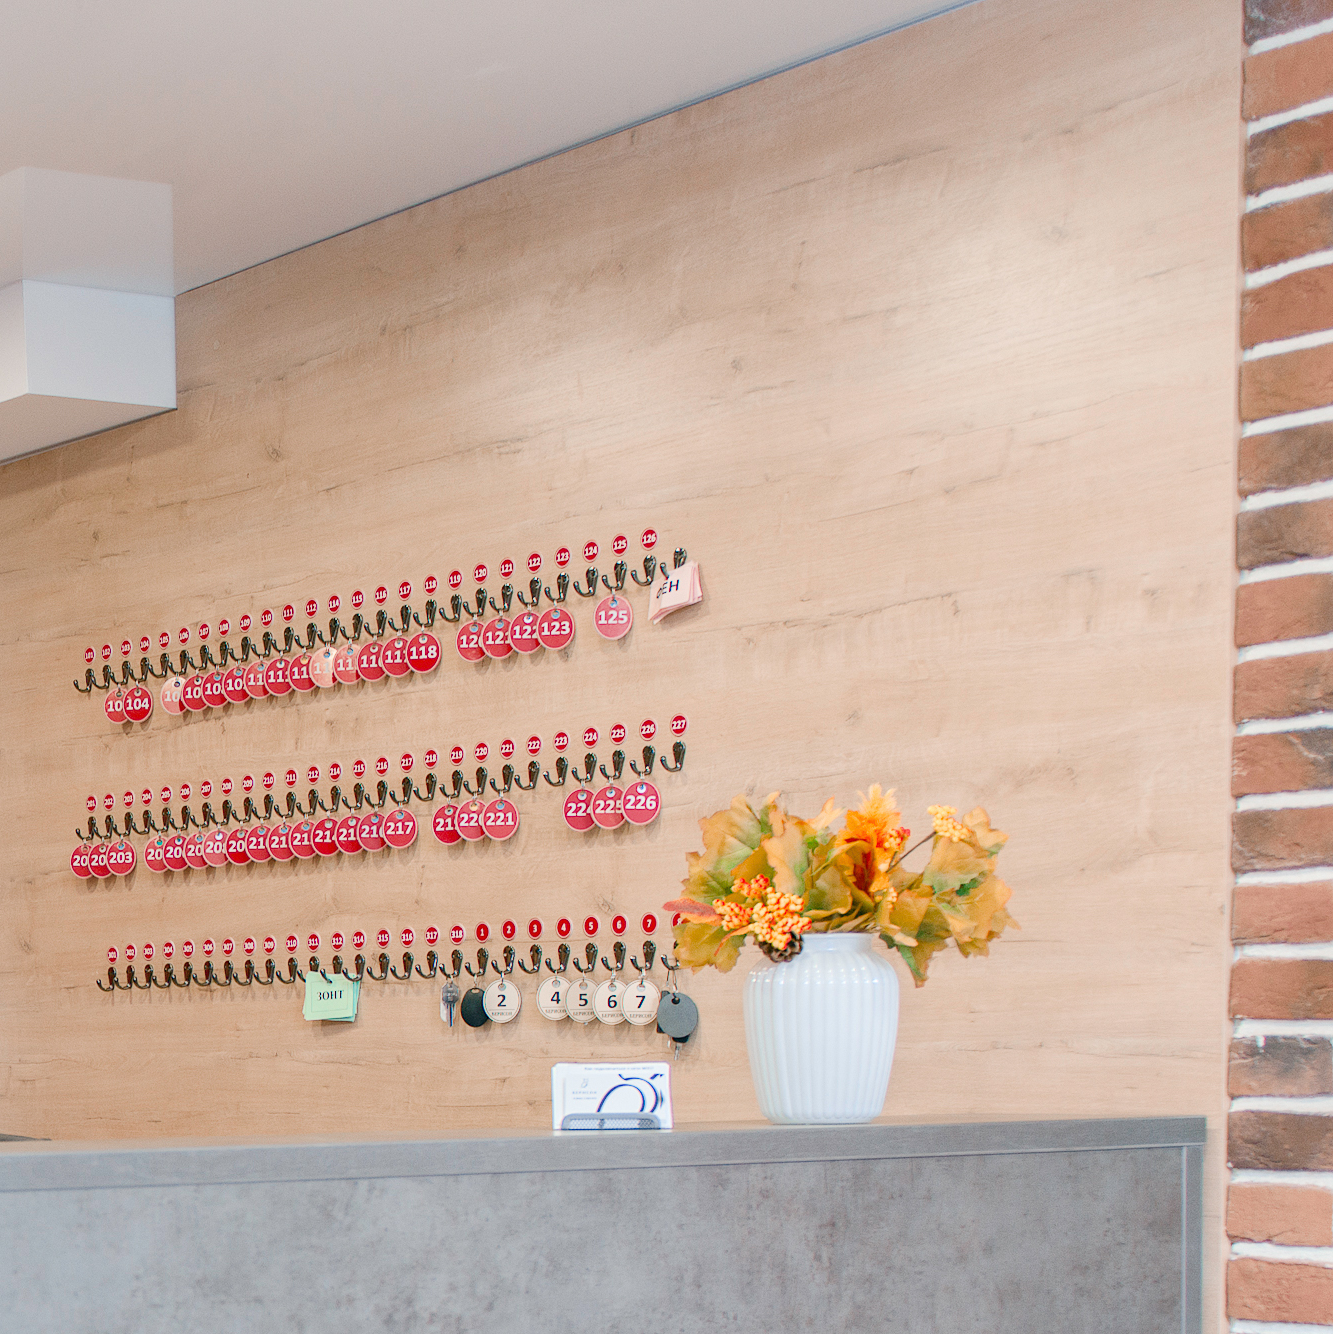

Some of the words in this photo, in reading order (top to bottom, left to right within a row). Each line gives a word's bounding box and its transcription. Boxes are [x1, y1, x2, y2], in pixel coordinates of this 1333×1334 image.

[643, 534, 656, 543] 126
[614, 539, 627, 549] 125
[585, 546, 597, 556] 124
[556, 552, 569, 561] 123
[528, 557, 541, 567] 122
[475, 569, 487, 577] 120
[501, 563, 513, 573] 121
[425, 580, 437, 589] 118
[449, 575, 461, 584] 119
[376, 590, 387, 599] 116
[399, 586, 411, 594] 117
[329, 599, 339, 608] 114
[352, 595, 363, 603] 115
[284, 609, 294, 617] 111
[306, 604, 317, 612] 112
[262, 614, 272, 622] 110
[599, 610, 627, 624] 125
[240, 619, 250, 627] 109
[199, 627, 209, 635] 107
[541, 622, 570, 635] 123
[385, 651, 406, 663] 11
[410, 646, 437, 659] 118
[337, 659, 353, 670] 11
[361, 655, 382, 667] 11
[292, 667, 308, 679] 11
[314, 663, 330, 674] 11
[227, 679, 245, 690] 10
[248, 674, 263, 685] 11
[186, 687, 201, 698] 10
[205, 683, 222, 695] 10
[164, 691, 180, 702] 10
[107, 701, 122, 712] 10
[126, 698, 149, 710] 104
[641, 724, 655, 734] 226
[672, 720, 686, 729] 227
[584, 733, 597, 741] 224
[611, 729, 625, 737] 225
[528, 741, 540, 749] 222
[555, 736, 567, 745] 223
[476, 747, 487, 755] 220
[501, 744, 513, 753] 221
[425, 754, 437, 763] 218
[451, 751, 463, 759] 219
[376, 762, 387, 770] 216
[401, 758, 413, 766] 217
[330, 767, 341, 775] 214
[354, 764, 365, 772] 215
[263, 776, 273, 784] 210
[286, 773, 296, 781] 211
[308, 771, 318, 779] 212
[201, 785, 211, 793] 207
[626, 795, 656, 809] 226
[486, 812, 514, 825] 221
[387, 822, 413, 834] 217
[436, 818, 456, 831] 21
[315, 830, 335, 842] 21
[339, 828, 355, 840] 21
[361, 826, 383, 837] 21
[249, 837, 267, 849] 21
[271, 836, 287, 848] 21
[293, 833, 310, 845] 21
[188, 845, 202, 856] 20
[206, 842, 226, 853] 20
[229, 840, 244, 852] 20
[109, 852, 132, 863] 203
[147, 849, 162, 860] 20
[166, 847, 182, 858] 20
[73, 856, 88, 866] 20
[91, 855, 106, 866] 20
[561, 923, 566, 931] 4
[589, 922, 593, 930] 5
[617, 920, 622, 928] 6
[378, 934, 389, 942] 315
[402, 933, 413, 941] 316
[426, 932, 438, 940] 317
[451, 930, 463, 938] 318
[332, 937, 343, 945] 312
[317, 990, 344, 1001] ЗОНТ
[497, 995, 506, 1006] 2
[551, 992, 560, 1004] 4
[579, 994, 588, 1006] 5
[608, 995, 617, 1008] 6
[636, 996, 646, 1008] 7
